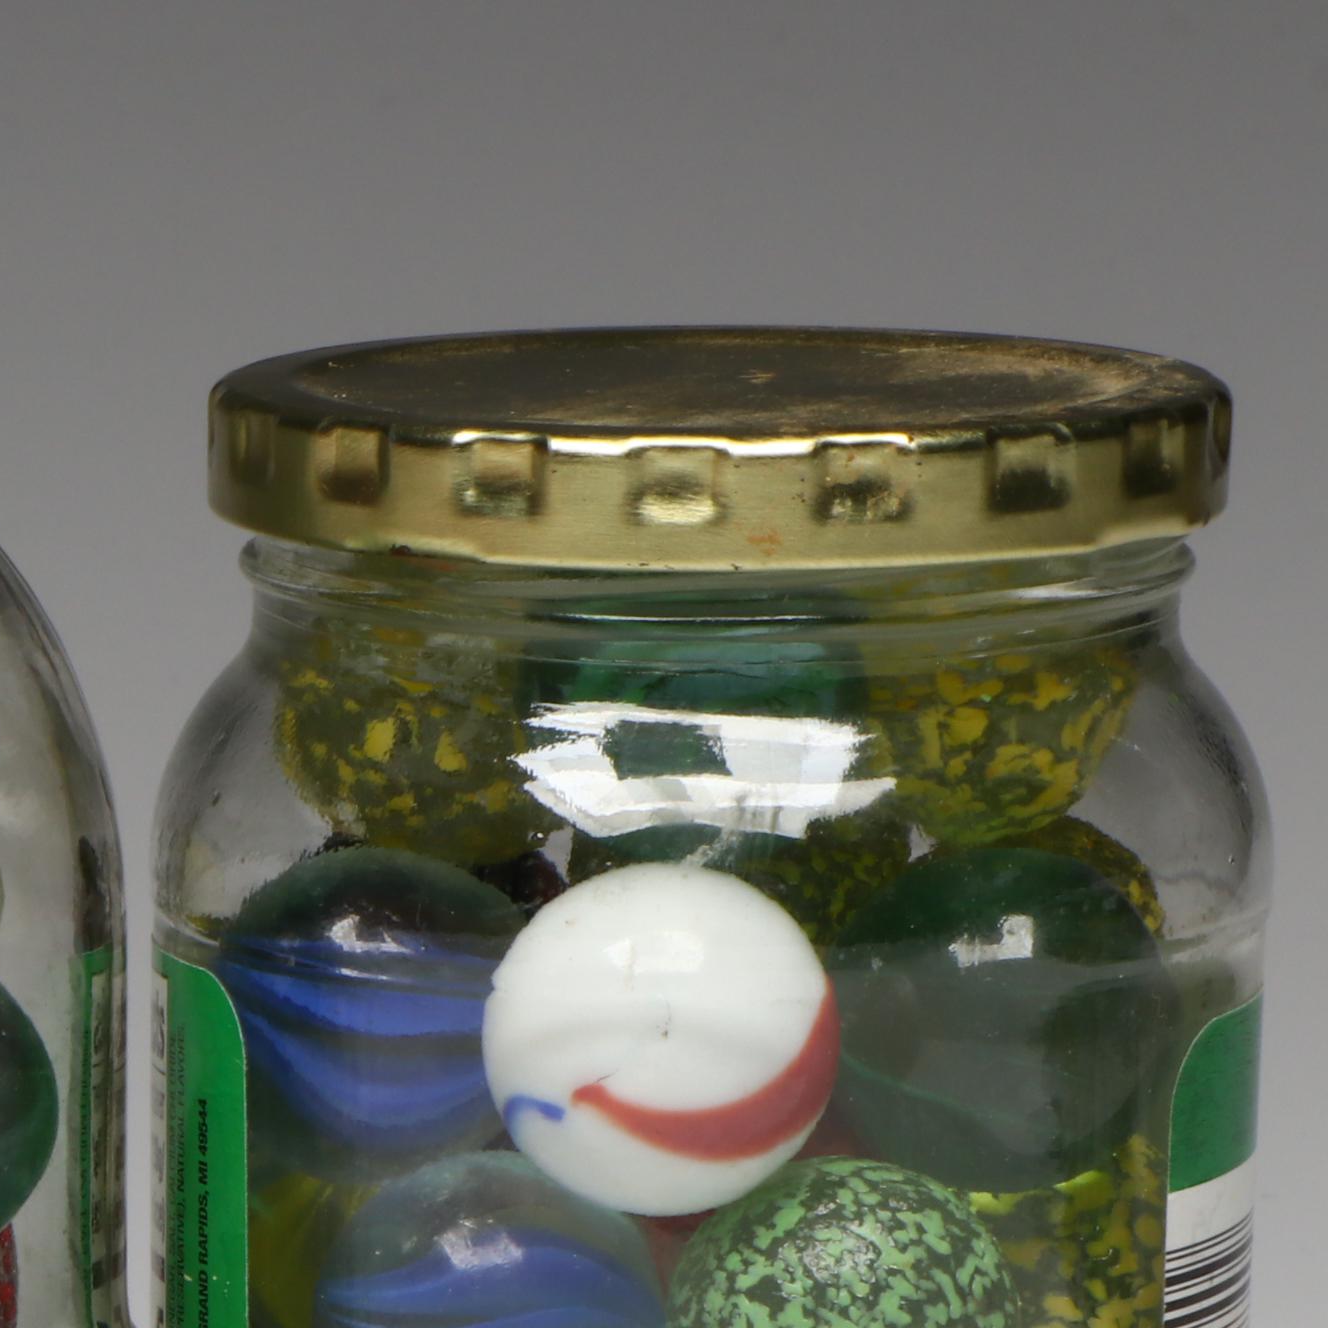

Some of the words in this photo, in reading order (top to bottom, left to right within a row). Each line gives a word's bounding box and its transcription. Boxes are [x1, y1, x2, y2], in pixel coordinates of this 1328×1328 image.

[197, 1098, 208, 1156] 49544
[197, 1161, 208, 1185] MI
[197, 1191, 209, 1265] RAPIDS,
